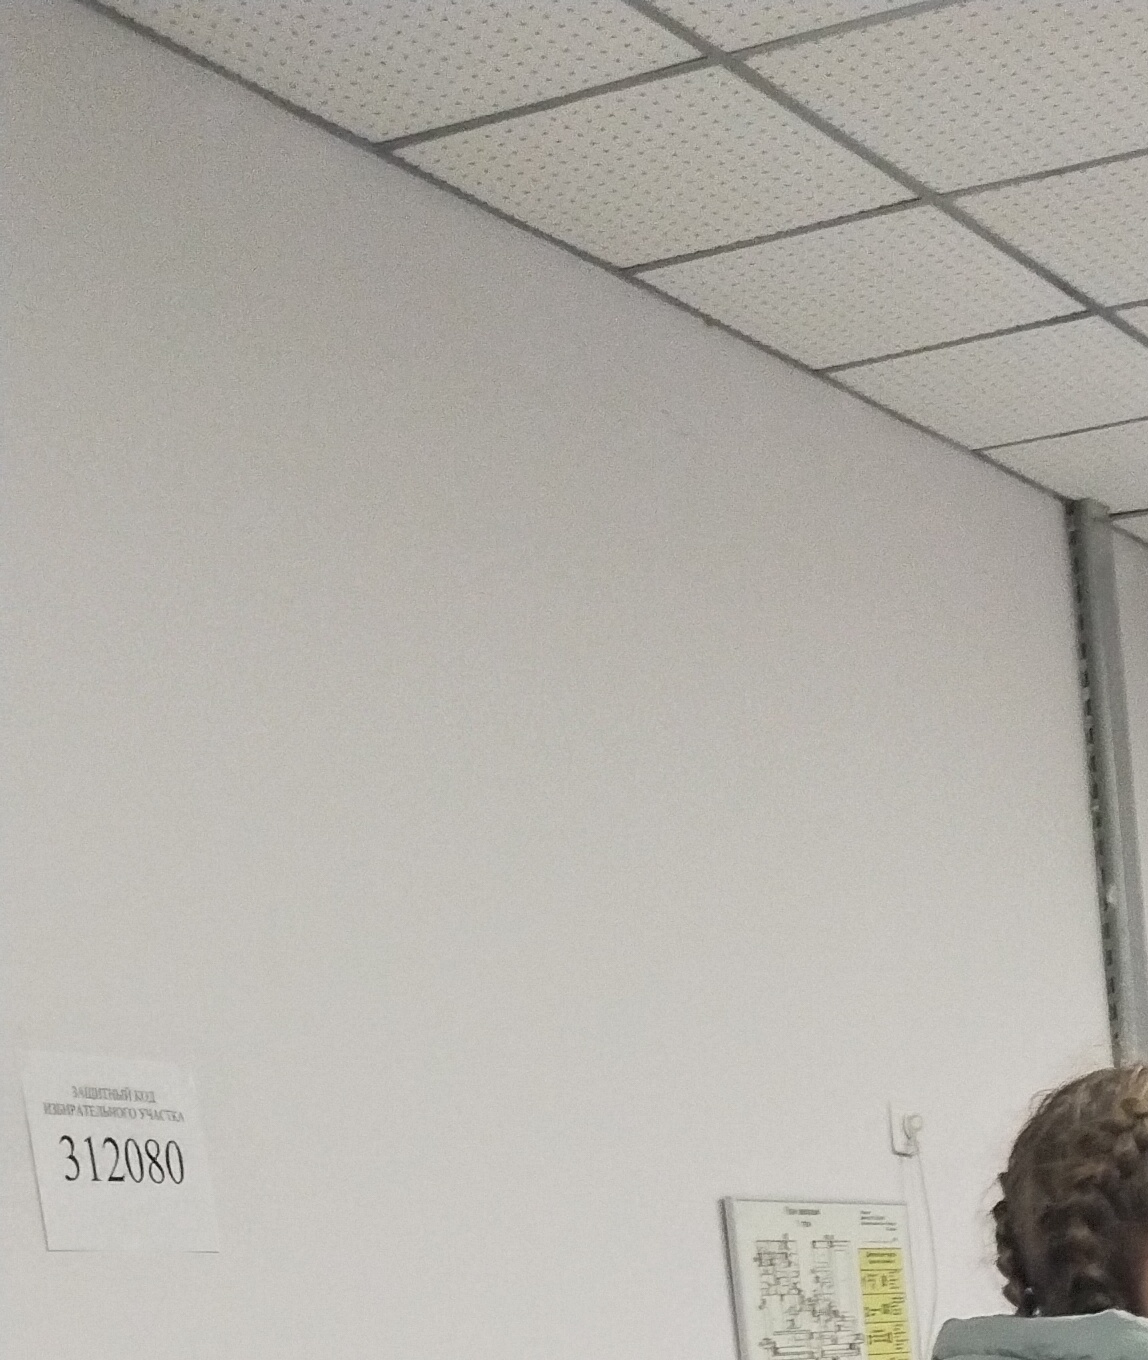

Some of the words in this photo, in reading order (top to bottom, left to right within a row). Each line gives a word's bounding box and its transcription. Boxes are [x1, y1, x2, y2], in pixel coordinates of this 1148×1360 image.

[71, 1085, 132, 1102] ЗАЩИТНЫЙ
[43, 1102, 137, 1120] ИЗБИРАТЕЛЬНОГО
[138, 1108, 185, 1123] УЧАСТКА
[58, 1134, 185, 1185] 312080
